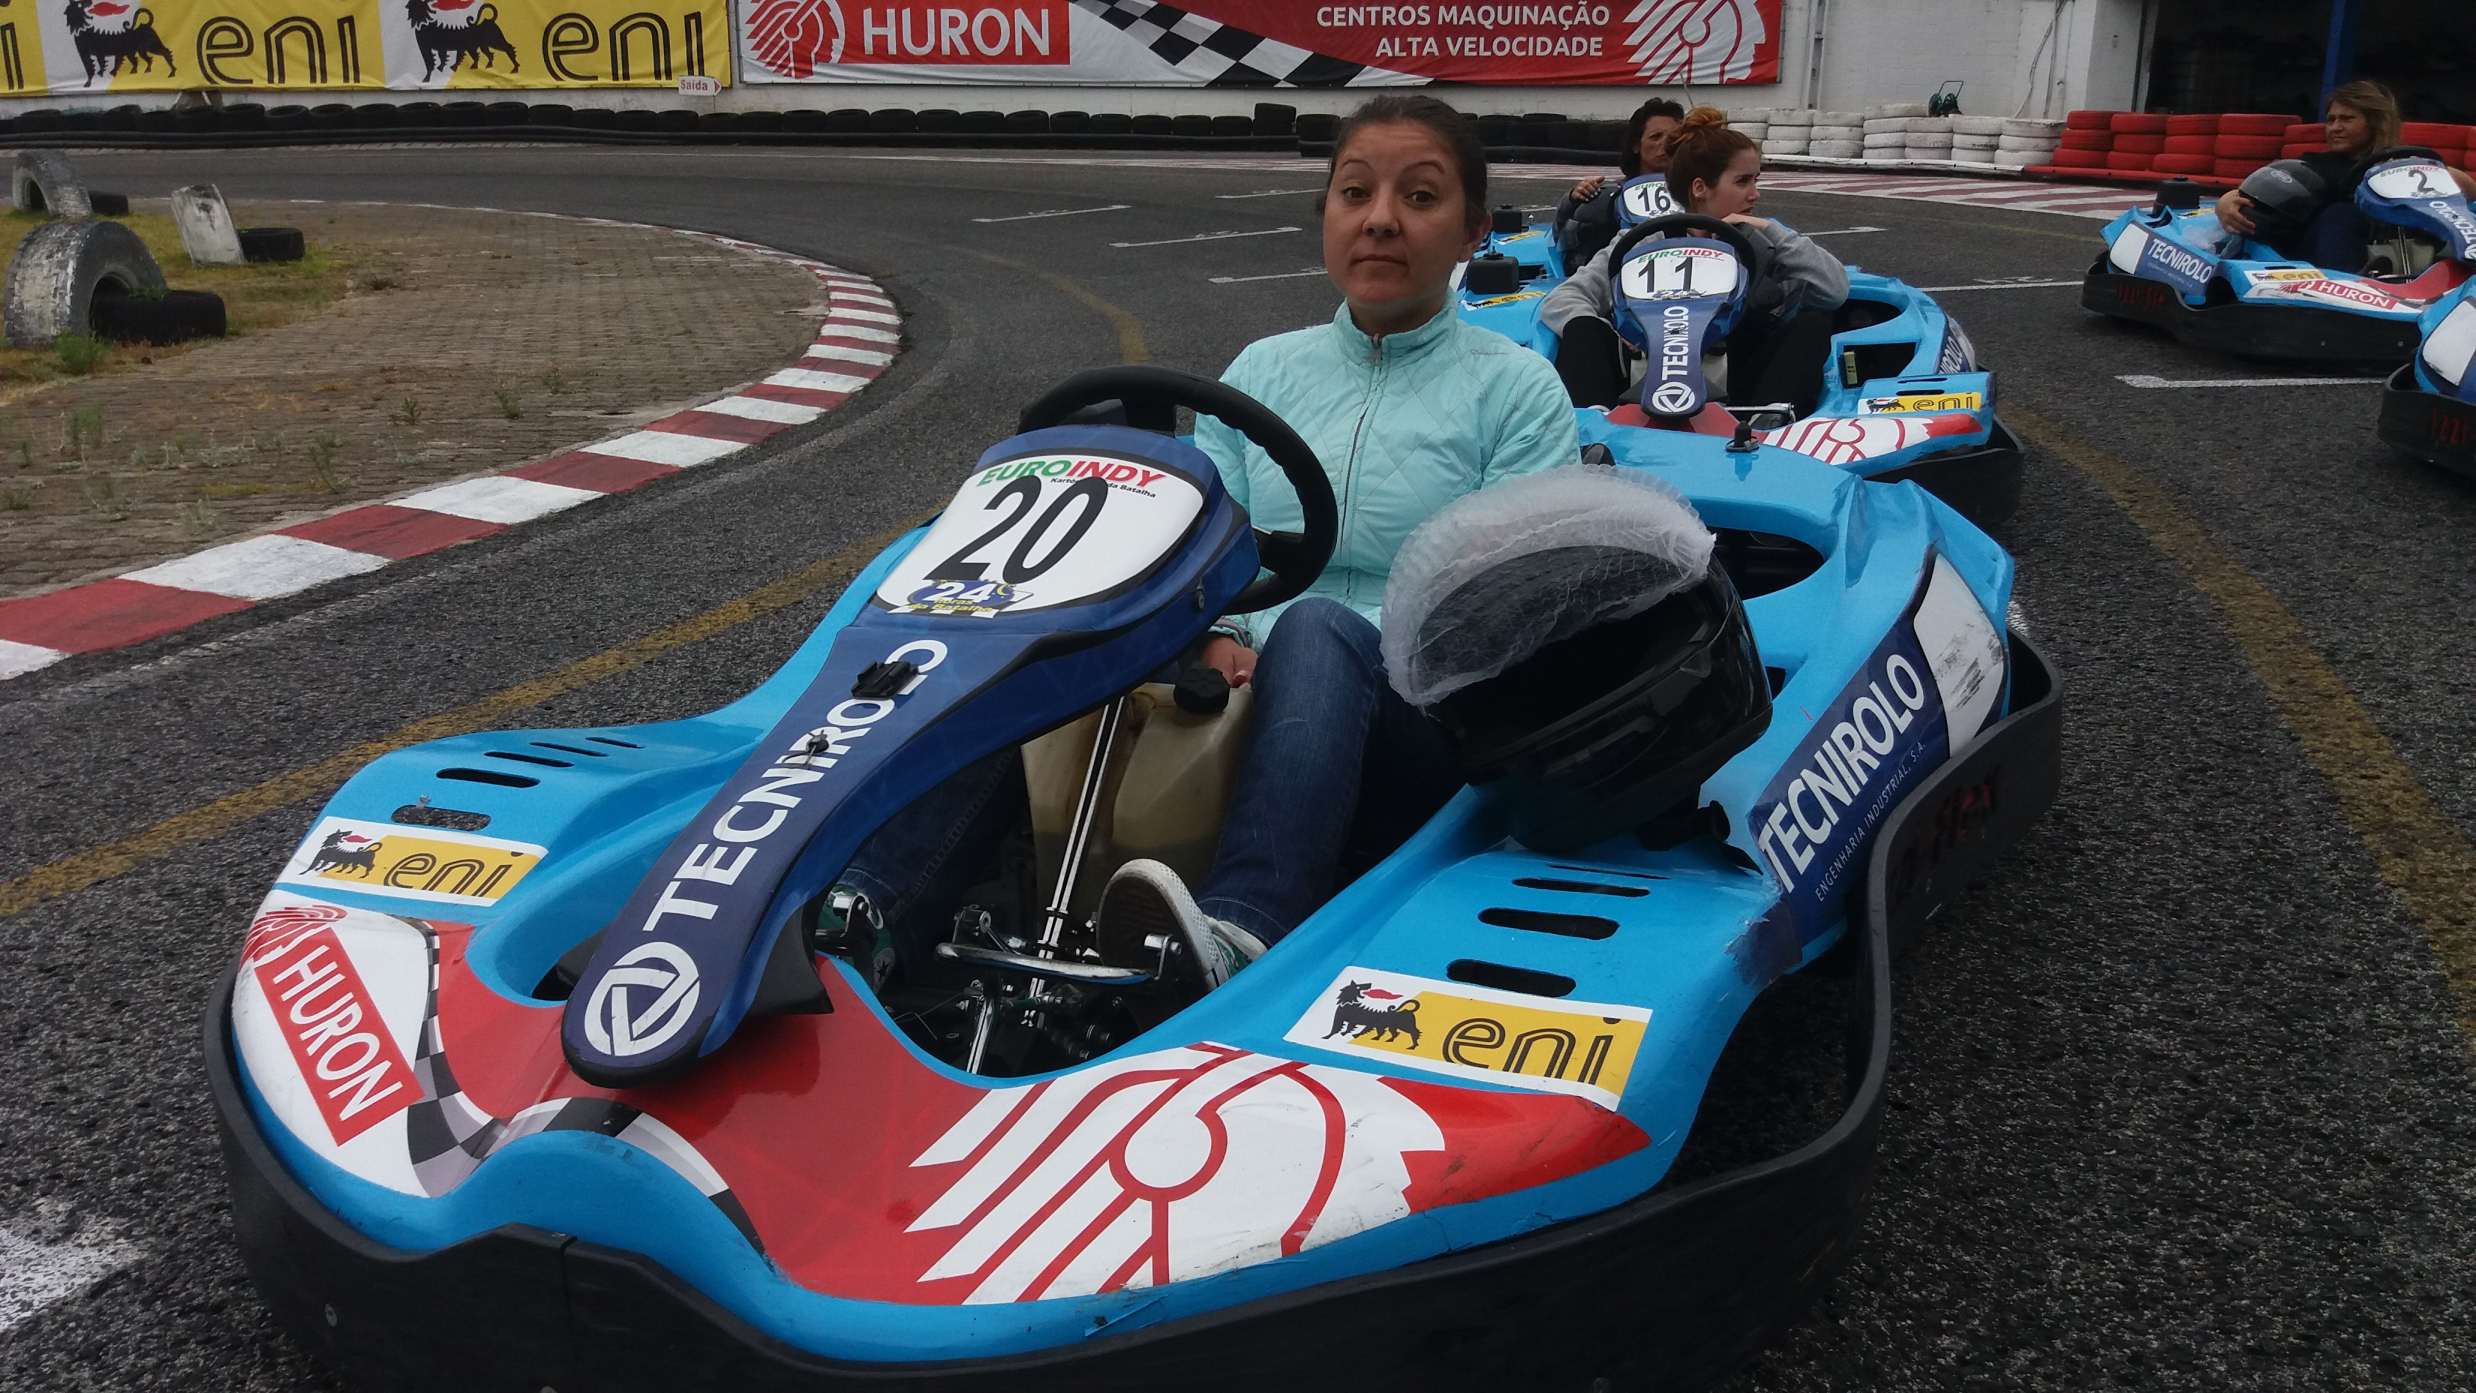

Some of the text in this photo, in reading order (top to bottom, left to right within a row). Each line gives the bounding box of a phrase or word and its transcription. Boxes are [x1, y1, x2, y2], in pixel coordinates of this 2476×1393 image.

[863, 6, 1050, 57] HURON
[1316, 0, 1611, 31] CENTROS MAQUINAÇÃO
[196, 13, 361, 85] eni
[541, 10, 705, 82] eni
[1375, 36, 1603, 59] ALTA VELOCIDADE
[1637, 186, 1671, 213] 16
[2408, 169, 2435, 193] 2
[1638, 248, 1724, 264] EUROINDY
[2147, 238, 2213, 284] TECNIROLO
[2318, 281, 2390, 308] HURON
[1912, 391, 1974, 413] eni
[976, 459, 1167, 488] EUROINDY
[1119, 484, 1156, 499] Batalha
[922, 474, 1109, 585] 20
[921, 581, 998, 603] 24
[1757, 653, 1925, 894] TECNIROLO
[383, 851, 525, 898] eni
[1814, 824, 1867, 903] ENGENHARIA
[272, 942, 404, 1122] HURON
[1441, 1016, 1623, 1086] eni
